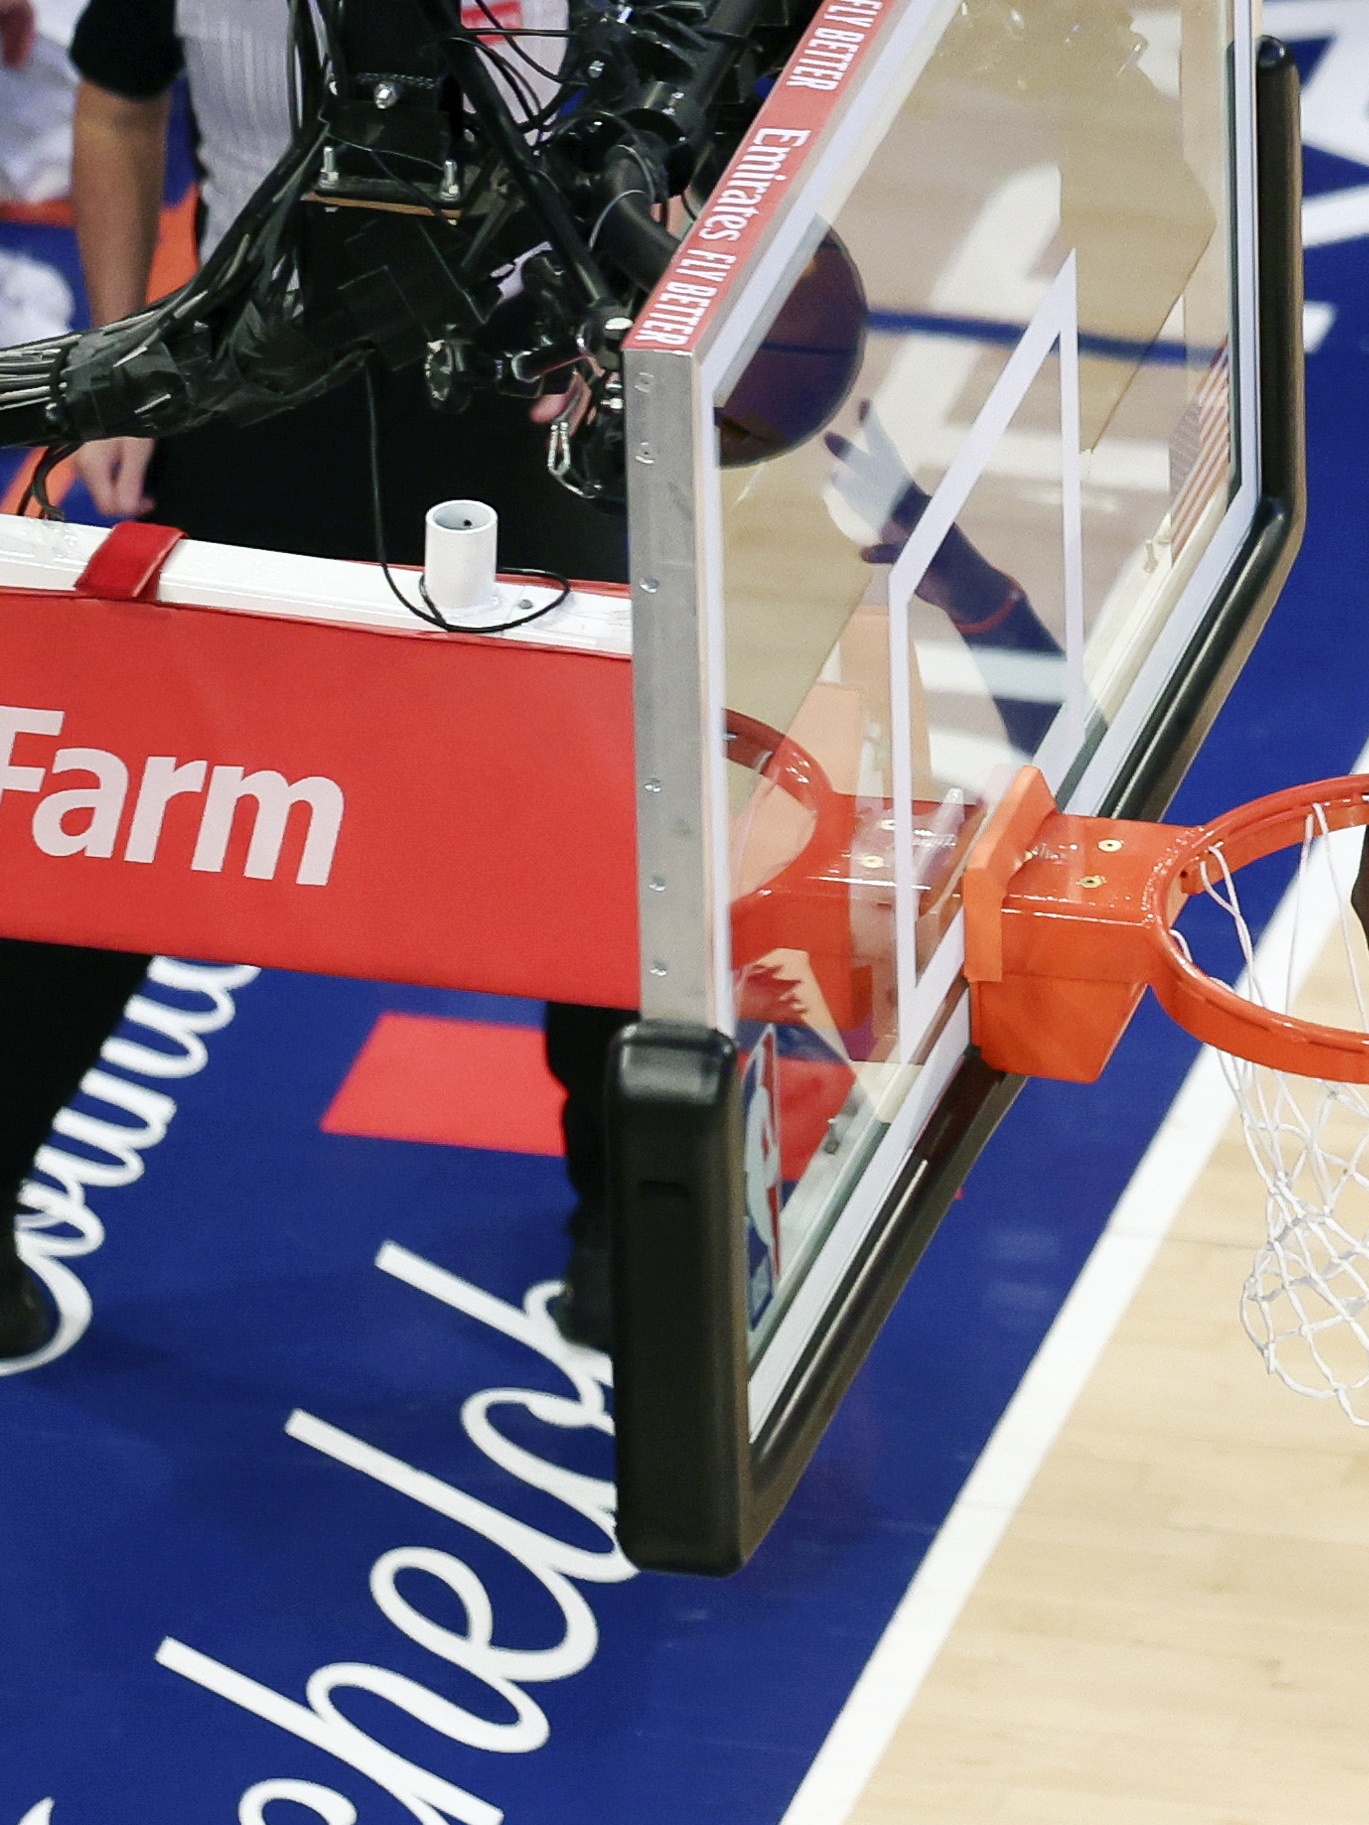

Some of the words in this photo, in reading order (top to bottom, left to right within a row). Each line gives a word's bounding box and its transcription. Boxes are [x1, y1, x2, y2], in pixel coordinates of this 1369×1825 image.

[787, 27, 864, 90] BETTER
[698, 127, 811, 242] Emirates
[676, 248, 736, 282] FLY
[633, 281, 719, 346] BETTER
[0, 705, 345, 887] Farm
